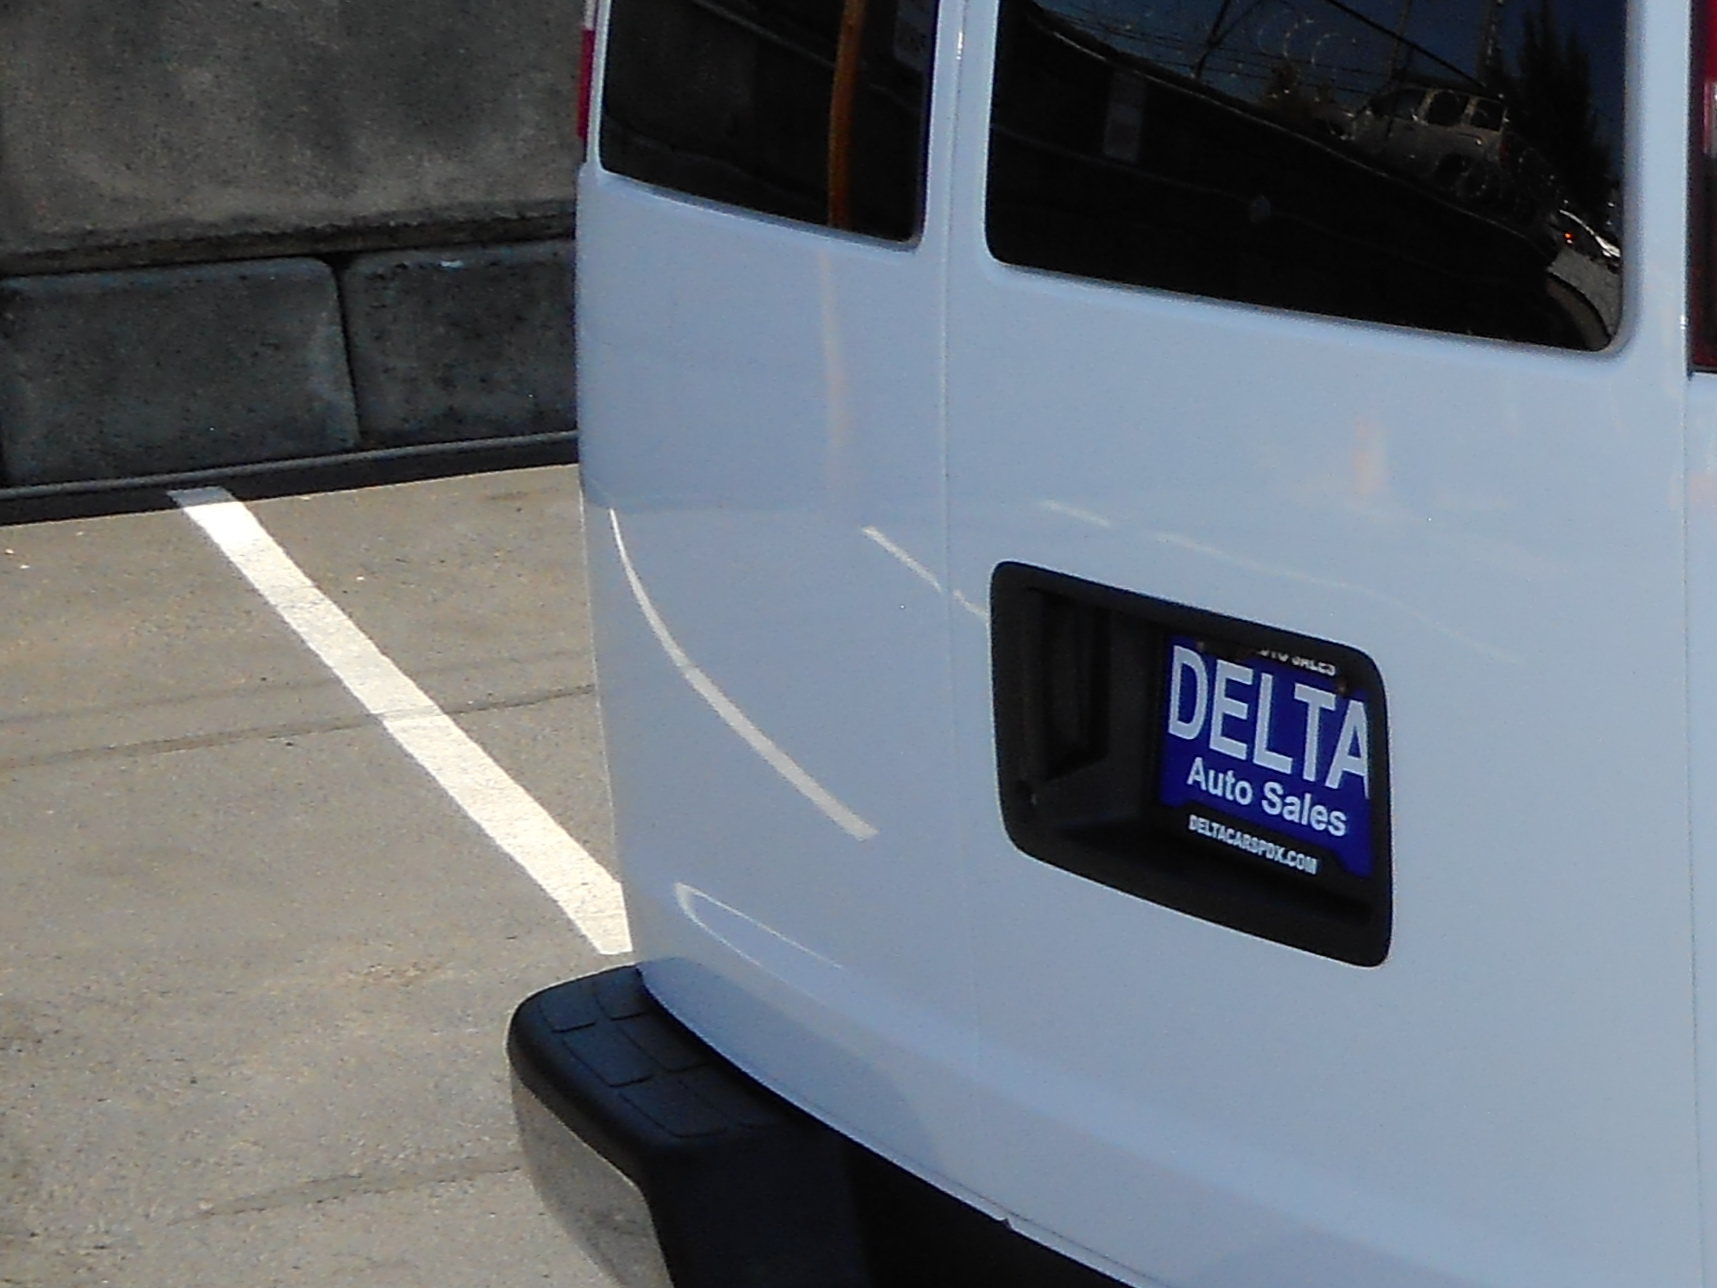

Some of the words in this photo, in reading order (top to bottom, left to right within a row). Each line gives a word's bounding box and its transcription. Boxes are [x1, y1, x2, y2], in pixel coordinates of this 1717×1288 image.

[1168, 645, 1369, 799] DELTA
[1187, 757, 1253, 805] Auto
[1262, 781, 1347, 837] Sales
[1188, 814, 1318, 875] DELTACARSPDX.COM
